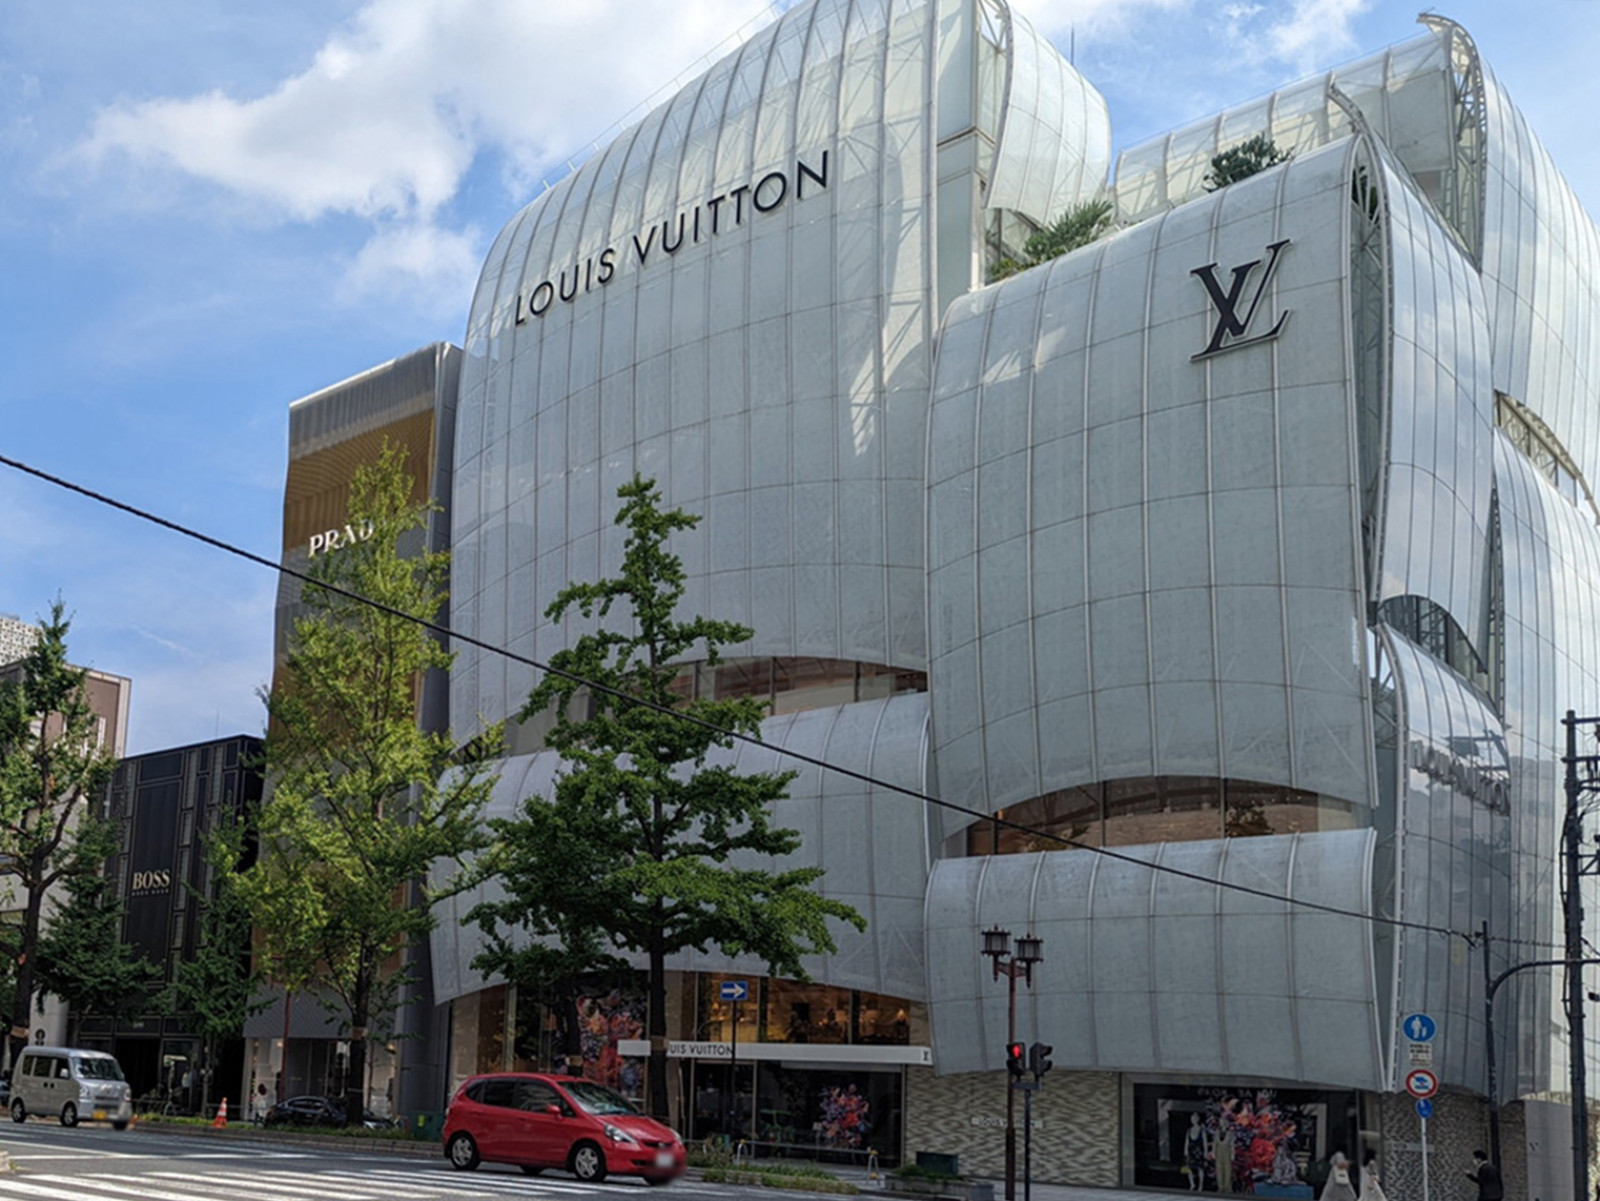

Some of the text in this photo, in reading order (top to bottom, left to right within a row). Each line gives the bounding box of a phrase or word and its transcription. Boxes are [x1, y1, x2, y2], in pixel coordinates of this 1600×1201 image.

[514, 150, 828, 326] LOUIS VUITTON
[308, 518, 375, 557] PRAD
[132, 868, 171, 891] BOSS
[689, 1044, 734, 1057] VUITTON
